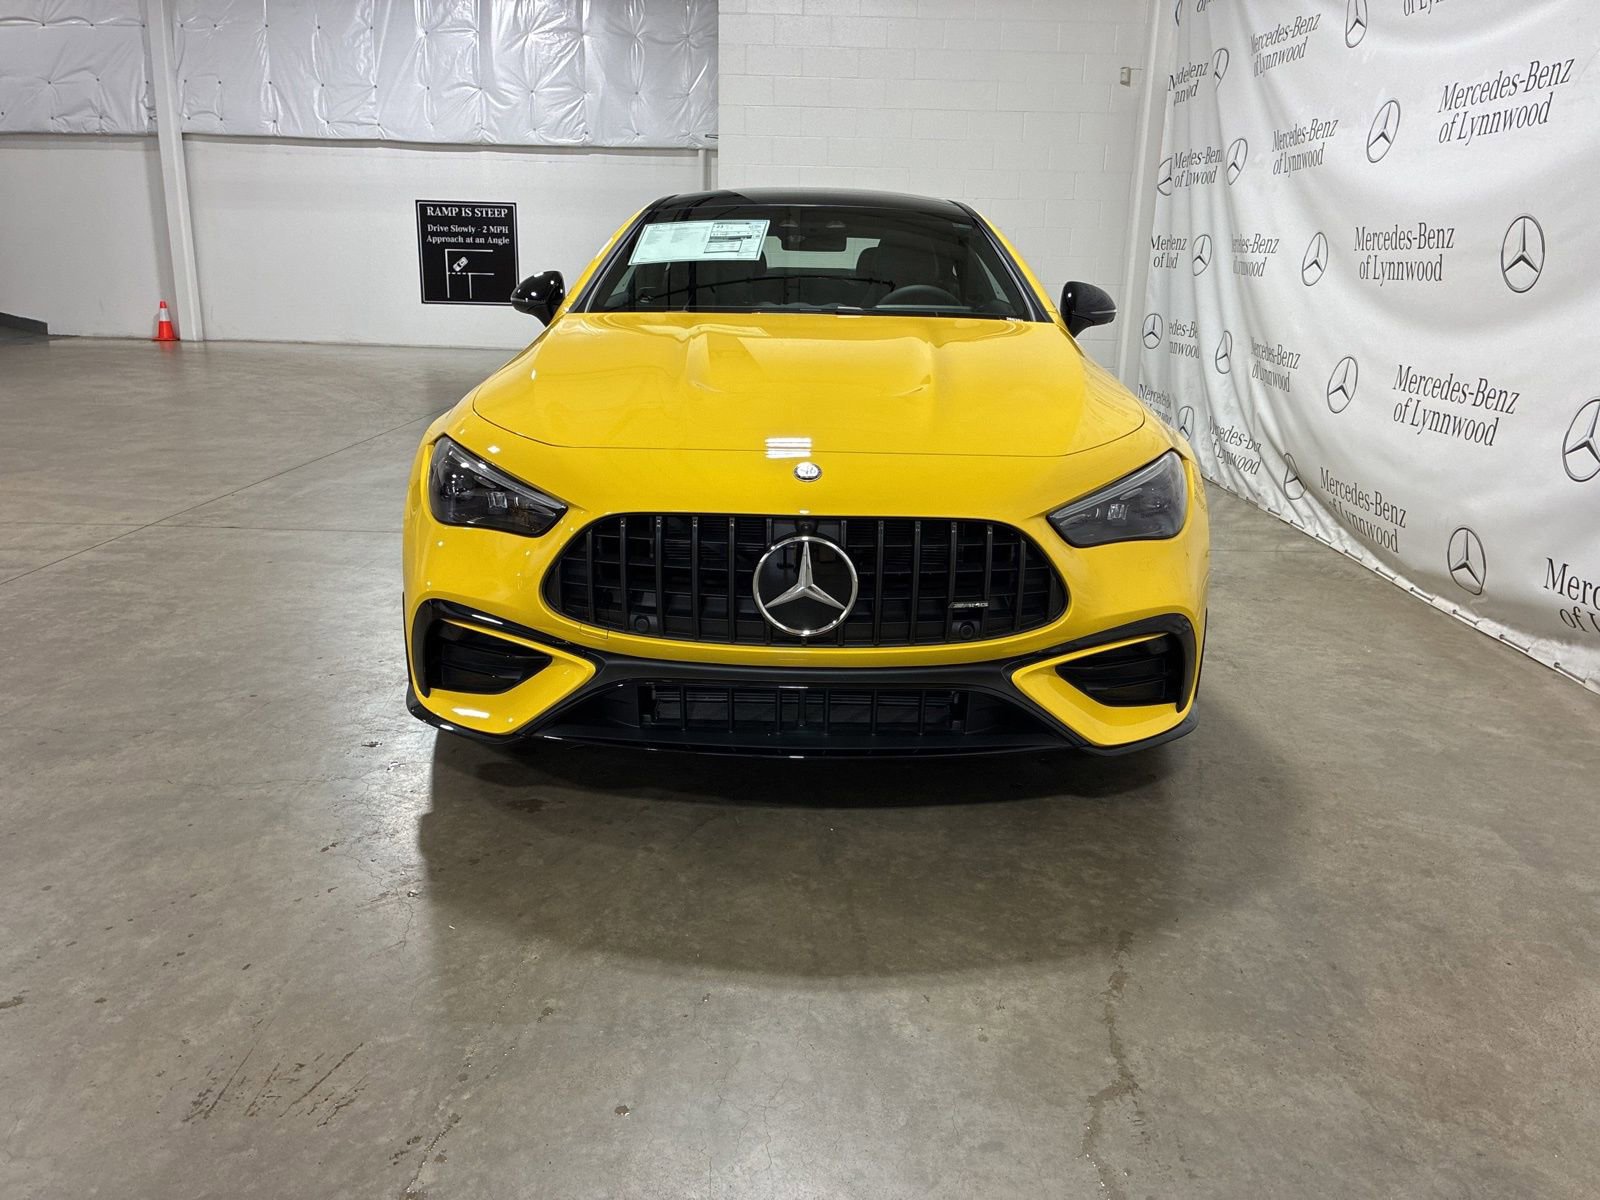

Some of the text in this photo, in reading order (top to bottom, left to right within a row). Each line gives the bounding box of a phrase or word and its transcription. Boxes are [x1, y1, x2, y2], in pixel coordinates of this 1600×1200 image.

[1436, 57, 1576, 113] Mercedes-Benz
[1271, 118, 1339, 152] Mercedes-Benz
[1438, 91, 1554, 146] of Lynnwood
[1272, 142, 1325, 178] of Lynnwood
[1174, 170, 1186, 188] of
[426, 206, 508, 218] RAMP IS STEEP
[427, 223, 449, 233] Drive
[450, 224, 476, 234] Slowly
[482, 225, 488, 233] 2
[489, 226, 509, 234] MPH
[426, 235, 464, 245] Approach
[487, 236, 510, 245] Angle
[1354, 222, 1455, 252] Mercedes-Benz
[1153, 252, 1166, 268] of
[1359, 254, 1443, 287] of Lynnwood
[1391, 364, 1520, 415] Mercedes-Benz
[1393, 397, 1500, 447] of Lynnwood
[1319, 466, 1407, 528] Mercedes-Benz
[1559, 606, 1590, 633] of
